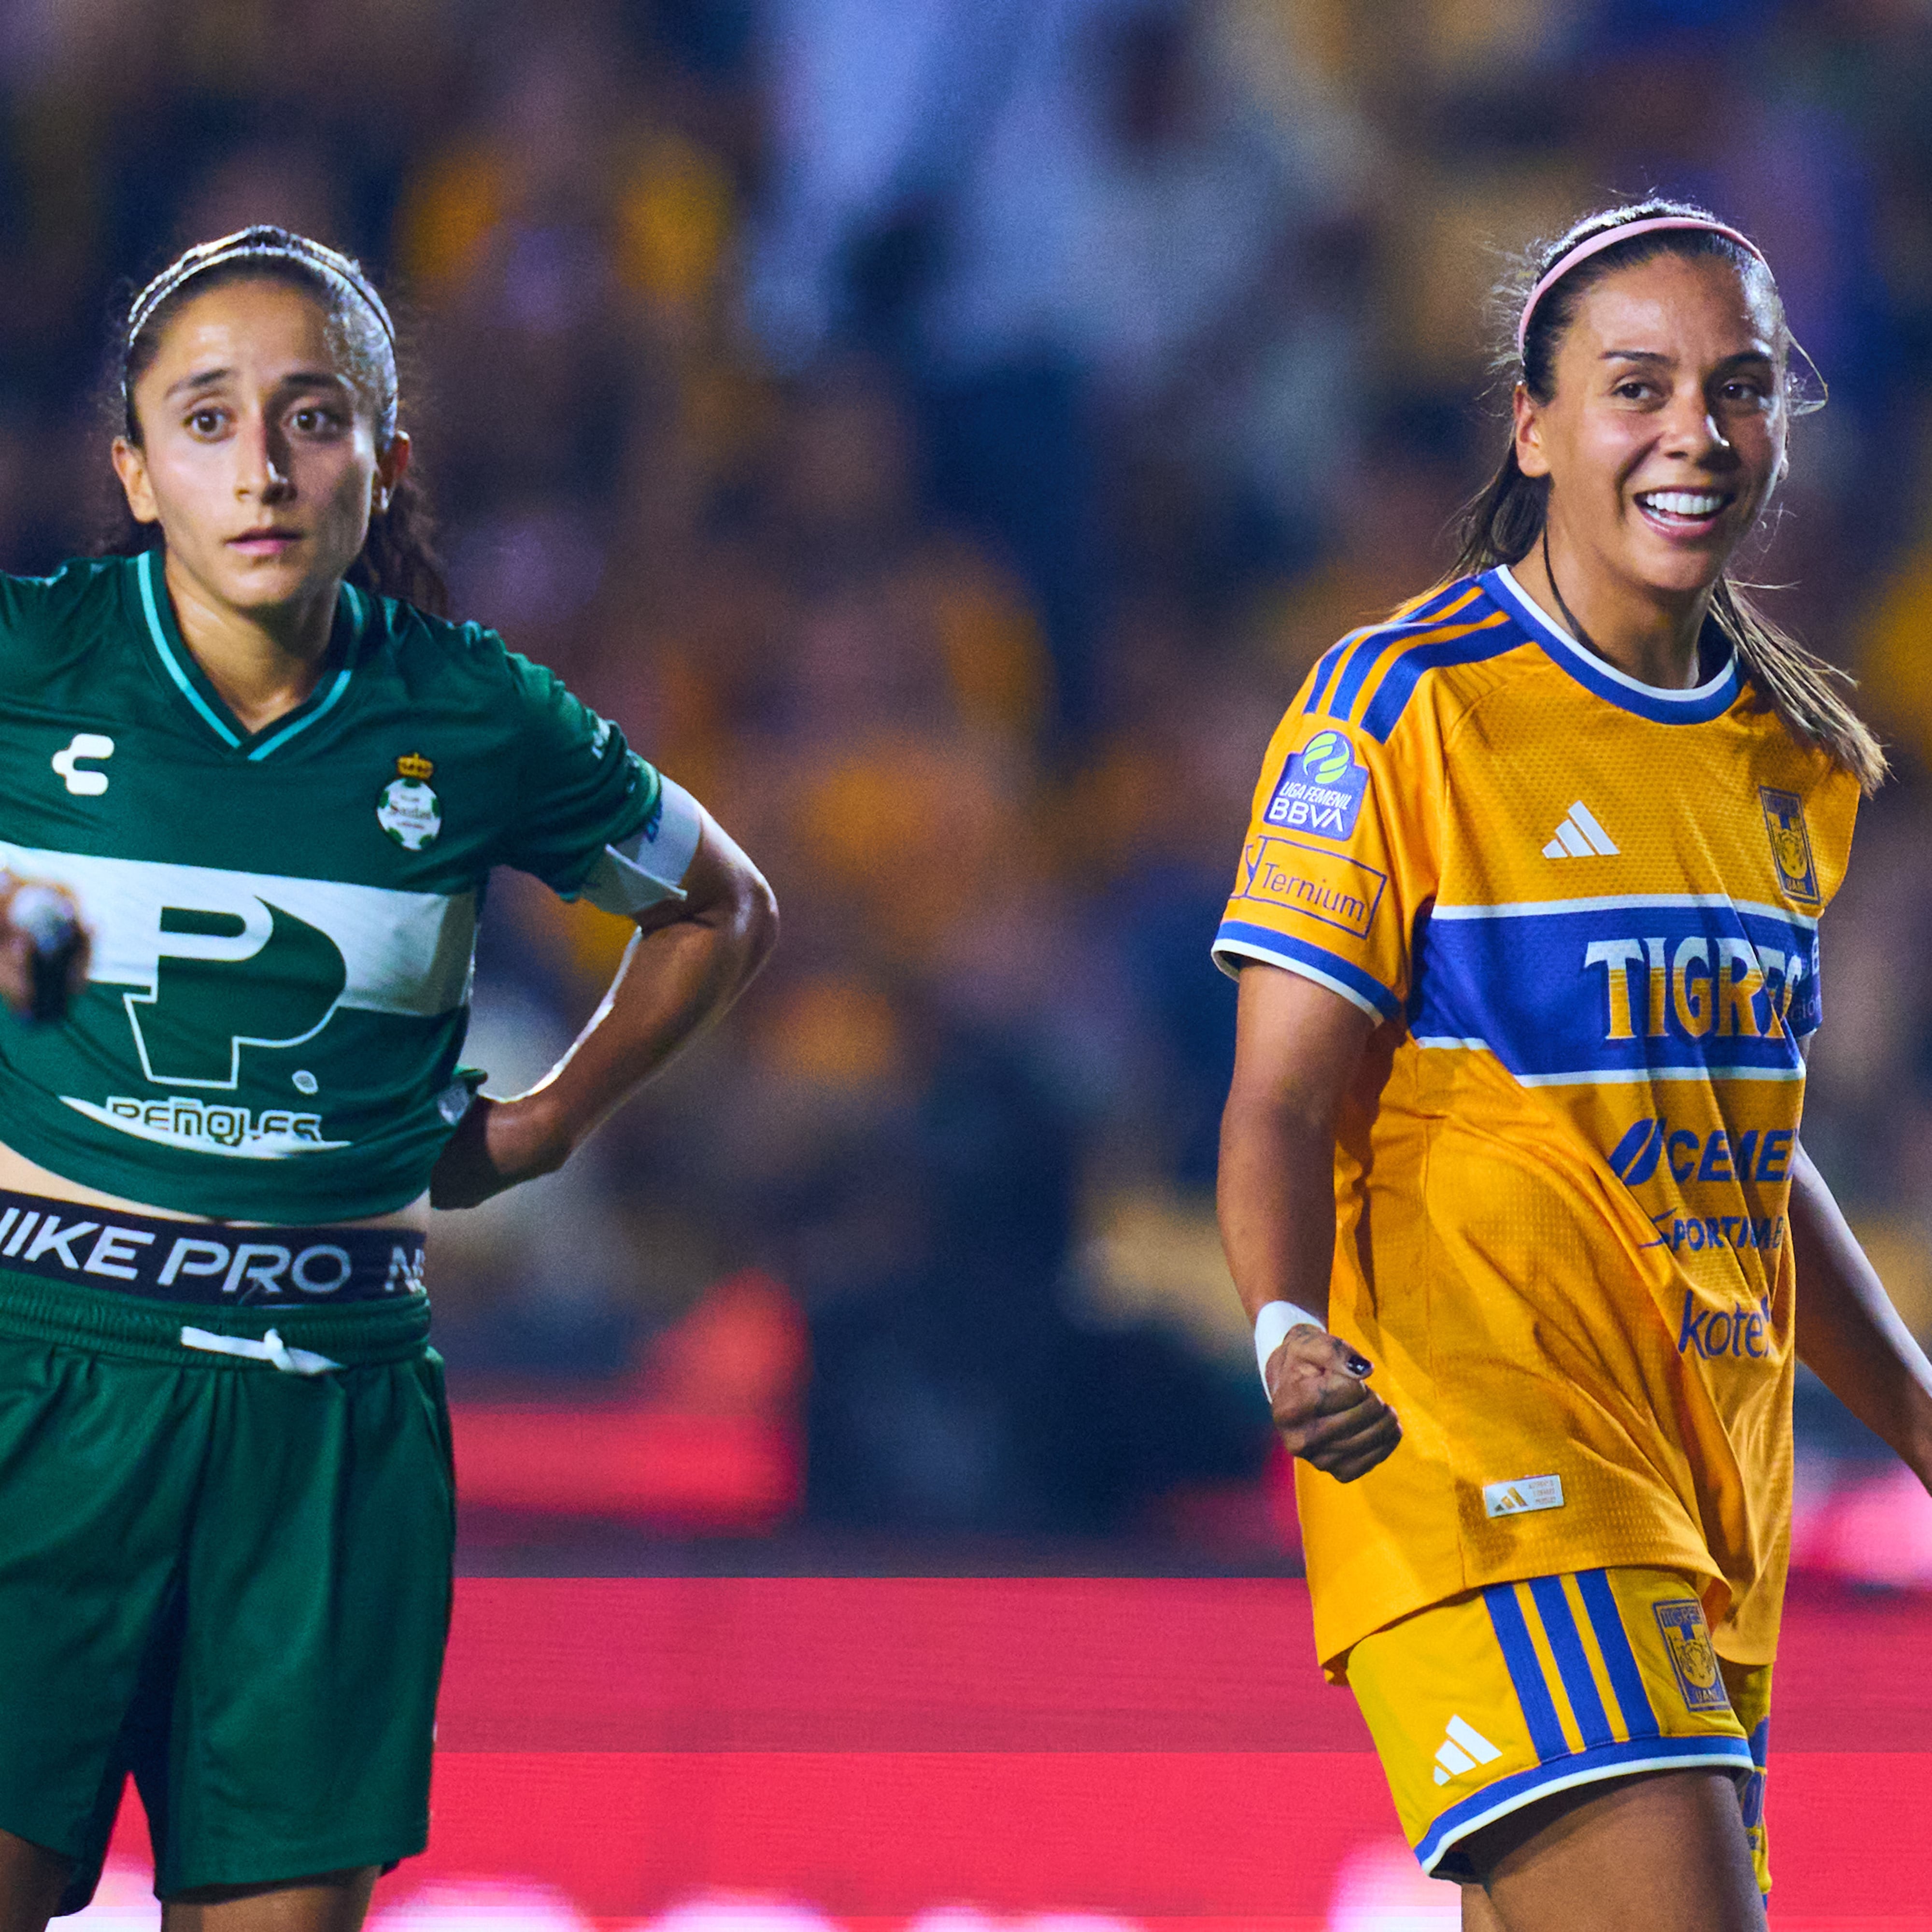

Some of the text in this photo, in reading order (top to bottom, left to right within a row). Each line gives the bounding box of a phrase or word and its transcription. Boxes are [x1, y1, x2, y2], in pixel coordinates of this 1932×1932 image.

[1268, 797, 1344, 832] BBVA
[1279, 781, 1352, 810] LIGA FEMENIL
[1262, 863, 1365, 922] Ternium
[1667, 1129, 1799, 1181] CEE
[156, 1237, 352, 1293] PRO
